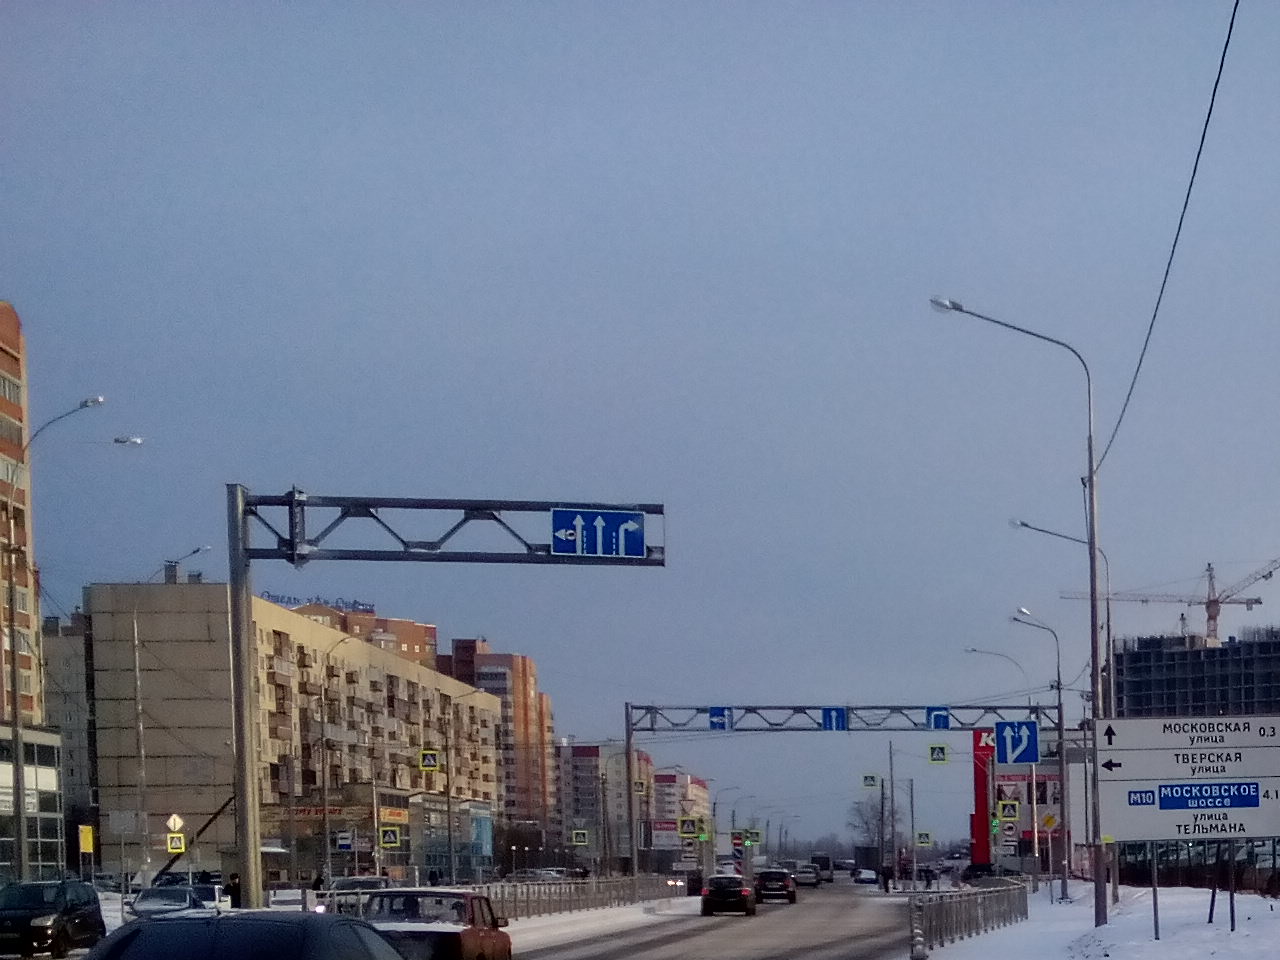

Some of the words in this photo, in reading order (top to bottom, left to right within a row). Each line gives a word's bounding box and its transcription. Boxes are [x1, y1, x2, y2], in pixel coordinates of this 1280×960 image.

[1162, 722, 1250, 734] МОСКОВСКАЯ
[1258, 726, 1276, 738] 0.3
[1188, 735, 1225, 746] улица
[1174, 752, 1242, 764] ТВЕРСКАЯ
[1190, 765, 1226, 776] улица
[1160, 784, 1258, 798] МОСКОВСКОЕ
[1262, 789, 1279, 800] 4.1
[1188, 798, 1231, 808] шоссе
[1192, 812, 1228, 823] улица
[1176, 822, 1246, 835] ТЕЛЬМАНА
